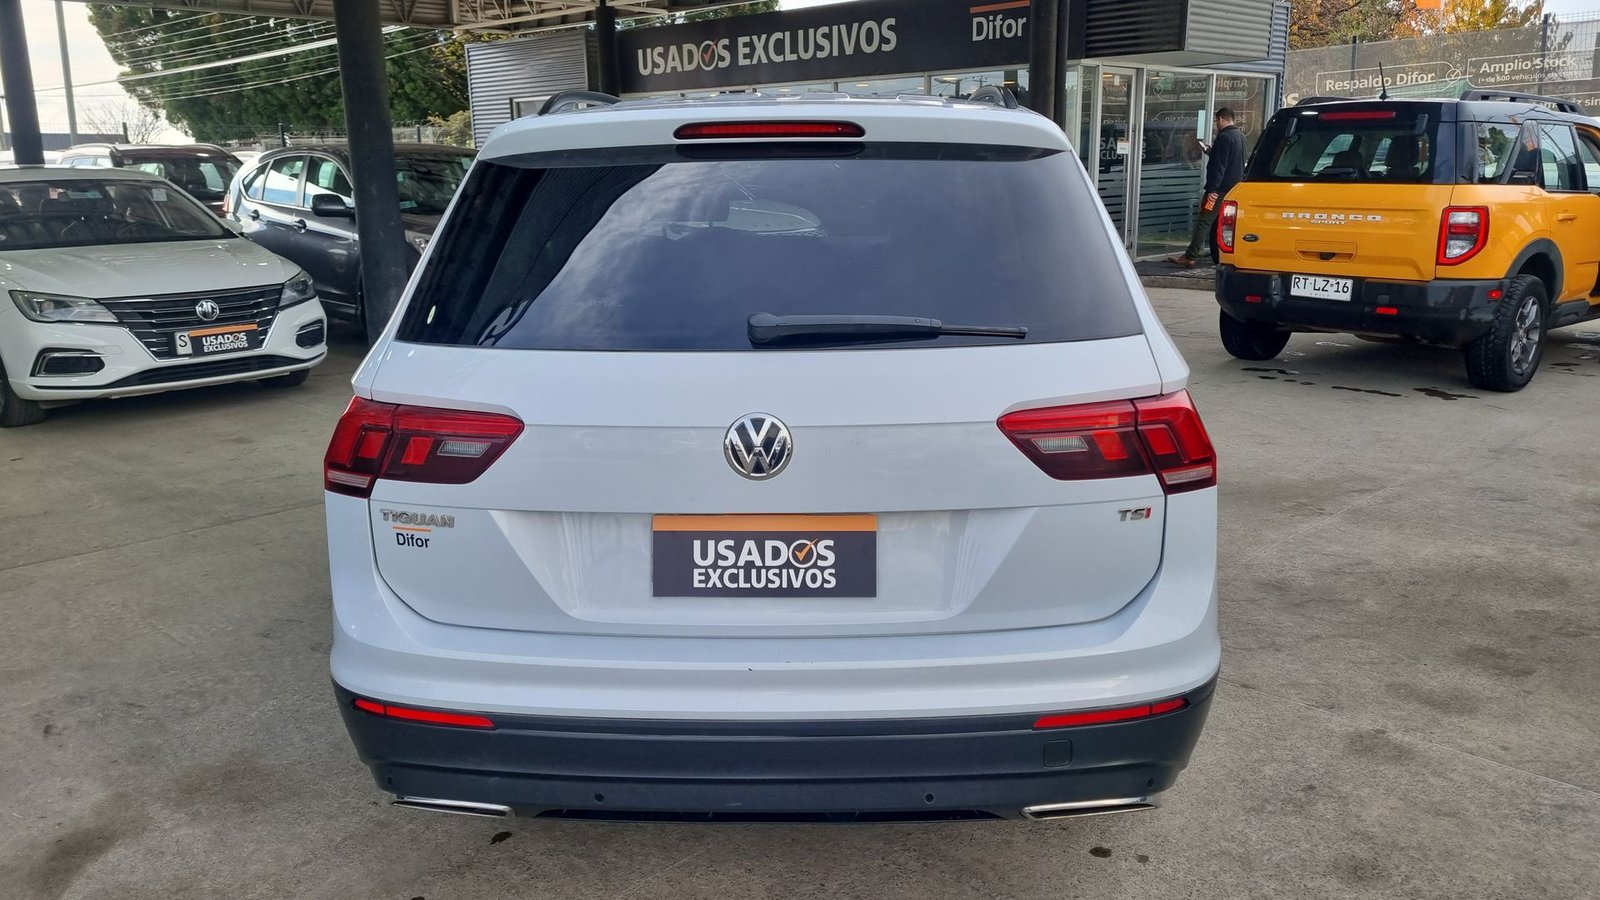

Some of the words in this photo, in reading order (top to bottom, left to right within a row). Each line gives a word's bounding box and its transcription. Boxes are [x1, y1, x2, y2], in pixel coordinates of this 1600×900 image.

[972, 14, 1027, 42] Difor
[637, 38, 731, 76] USADOS
[738, 18, 897, 66] EXCLUSIVOS
[1479, 59, 1532, 74] Amplio
[1535, 55, 1577, 69] Stock
[1326, 75, 1392, 92] Respaldo
[1397, 72, 1435, 85] Difor
[1282, 212, 1382, 221] BRONCO
[202, 333, 247, 346] USADOS
[204, 341, 248, 353] EXCLUSIVOS
[380, 508, 455, 528] TIGUAN
[396, 532, 430, 549] Difor
[693, 538, 836, 568] USADOS
[693, 568, 836, 588] EXCLUSIVOS
